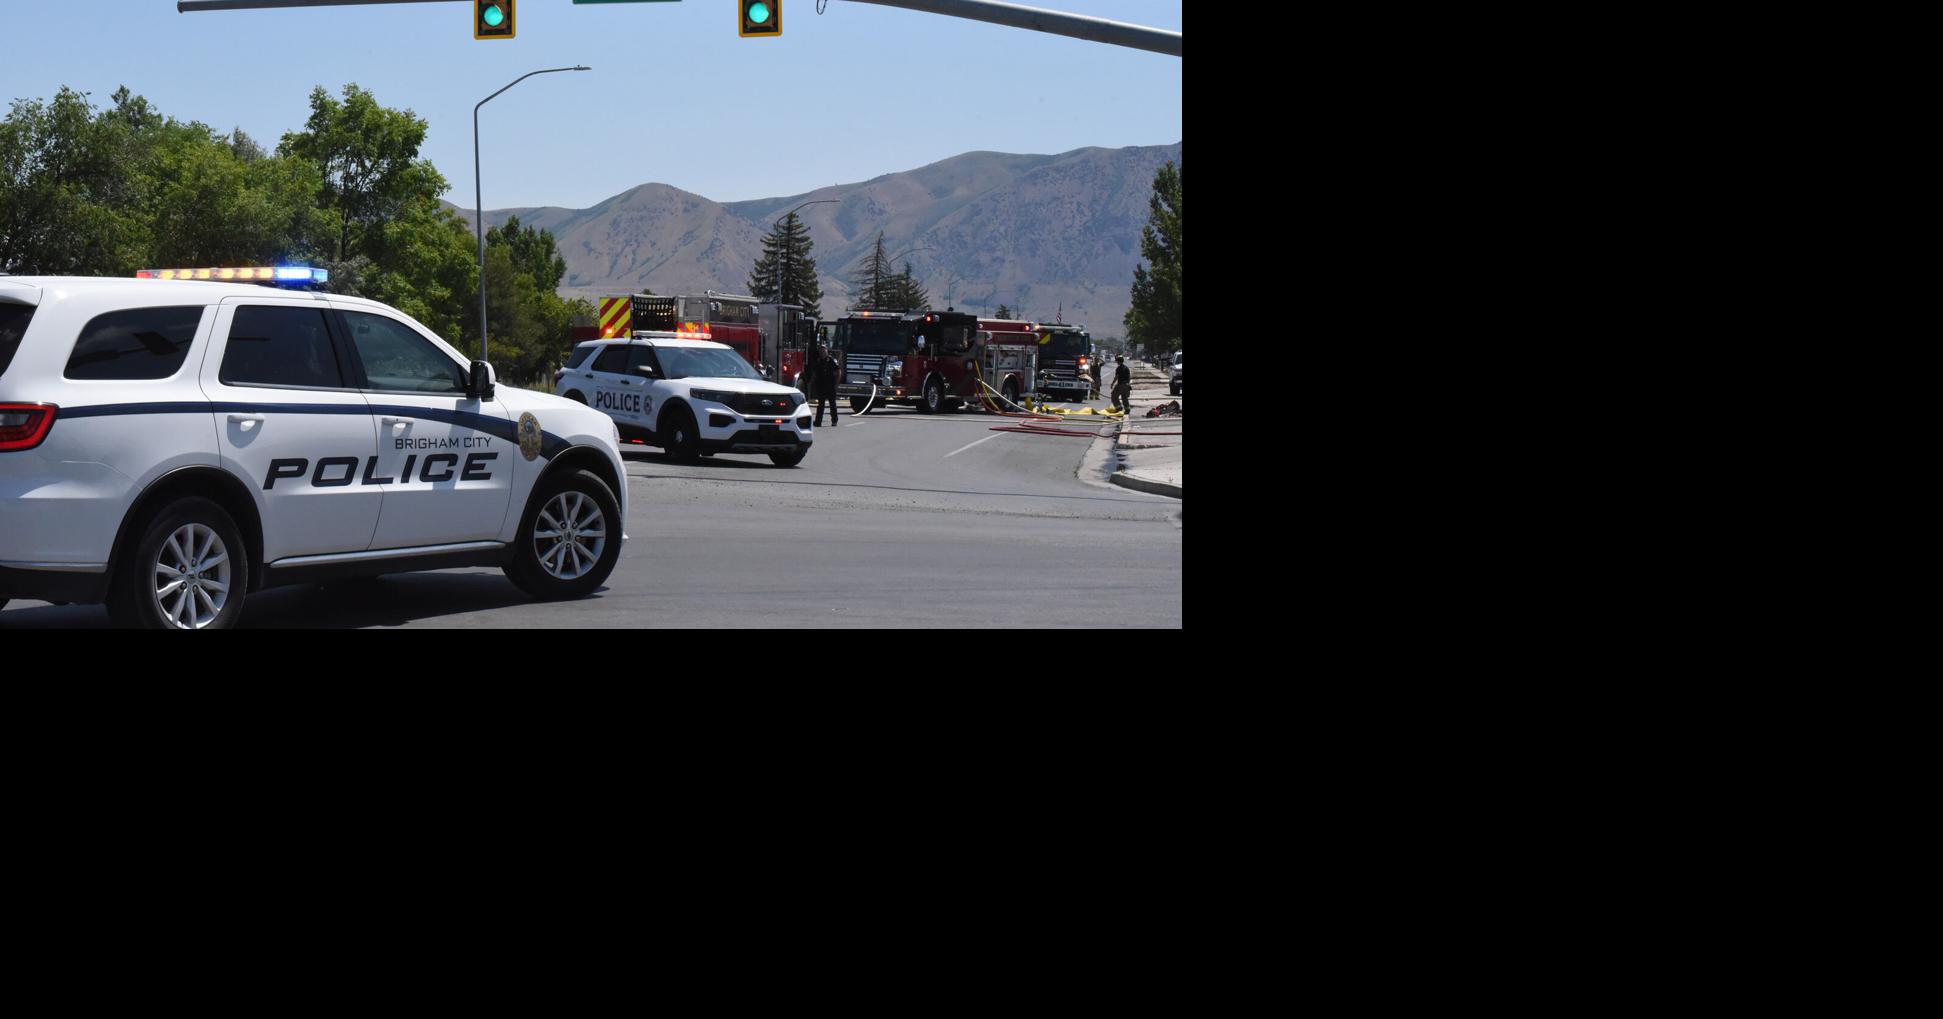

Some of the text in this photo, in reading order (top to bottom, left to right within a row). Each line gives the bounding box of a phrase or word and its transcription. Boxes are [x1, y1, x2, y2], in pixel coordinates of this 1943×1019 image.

[596, 390, 640, 413] POLICE
[395, 437, 491, 449] BRIGHAM CITY
[263, 452, 498, 490] POLICE
